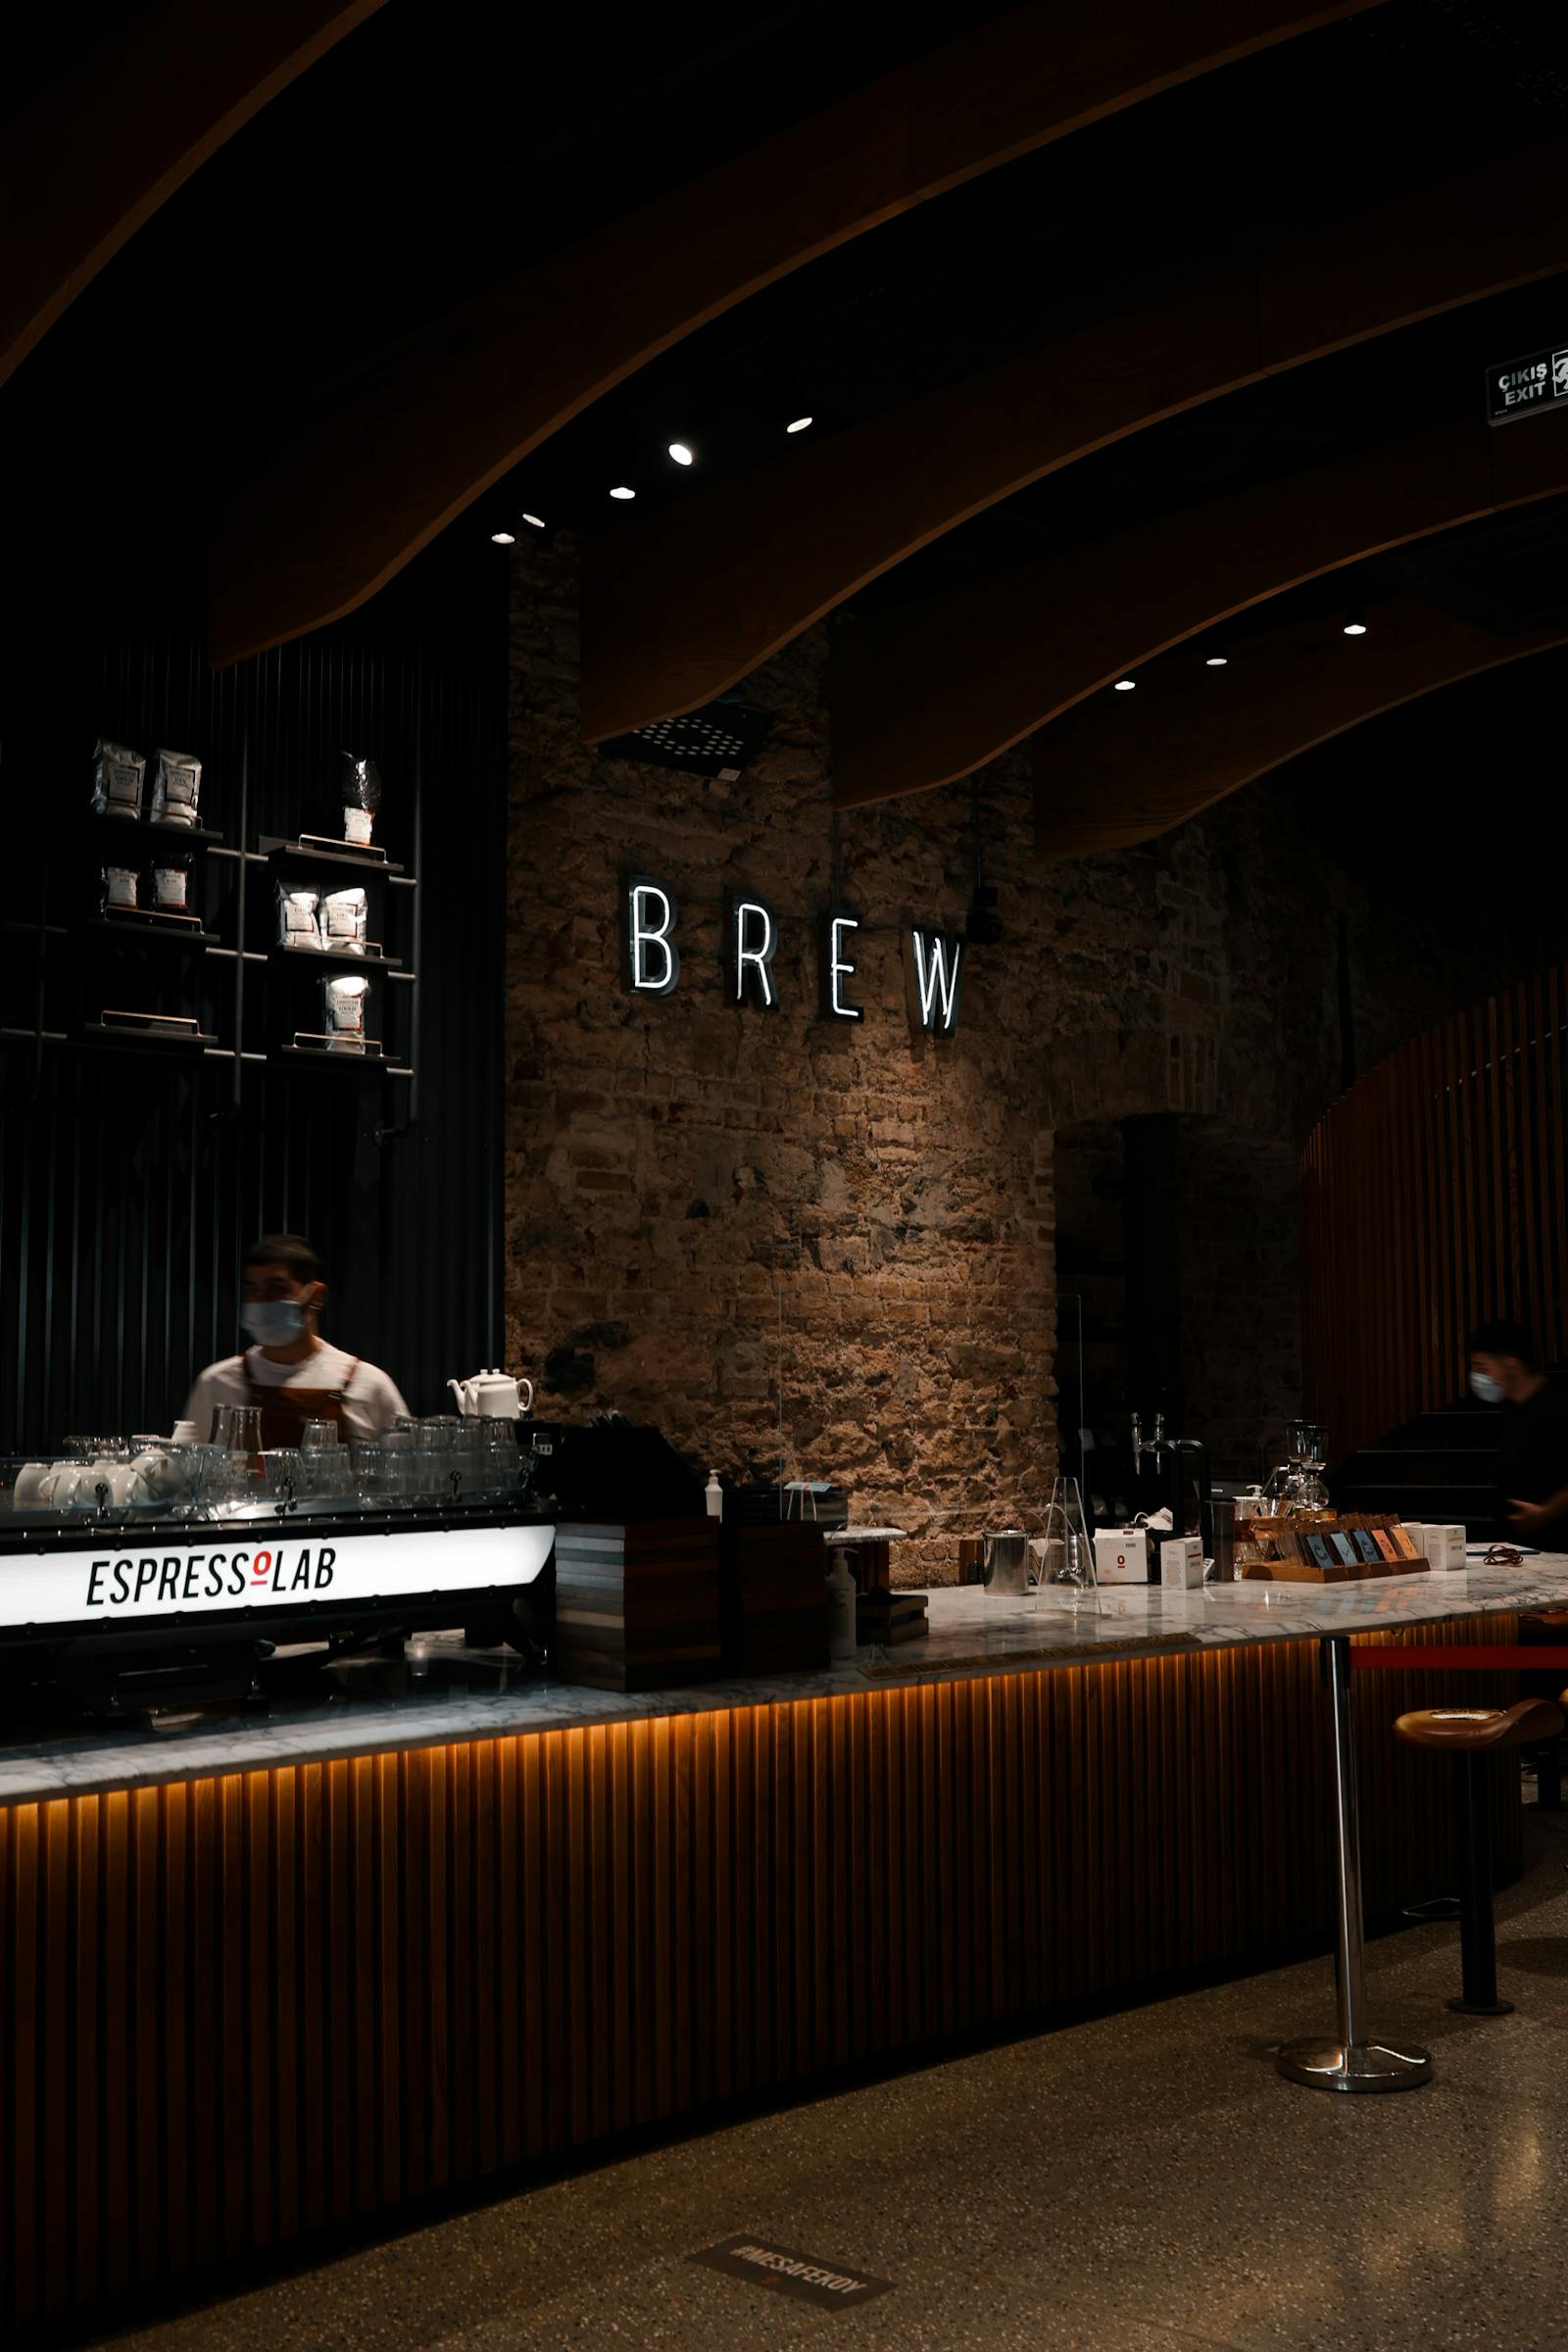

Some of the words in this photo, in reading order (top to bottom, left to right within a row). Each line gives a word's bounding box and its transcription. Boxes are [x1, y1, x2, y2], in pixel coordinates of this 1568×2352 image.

[1504, 380, 1546, 406] EXIT
[630, 883, 961, 1031] BREW
[86, 1547, 337, 1606] ESPRESSOLAB
